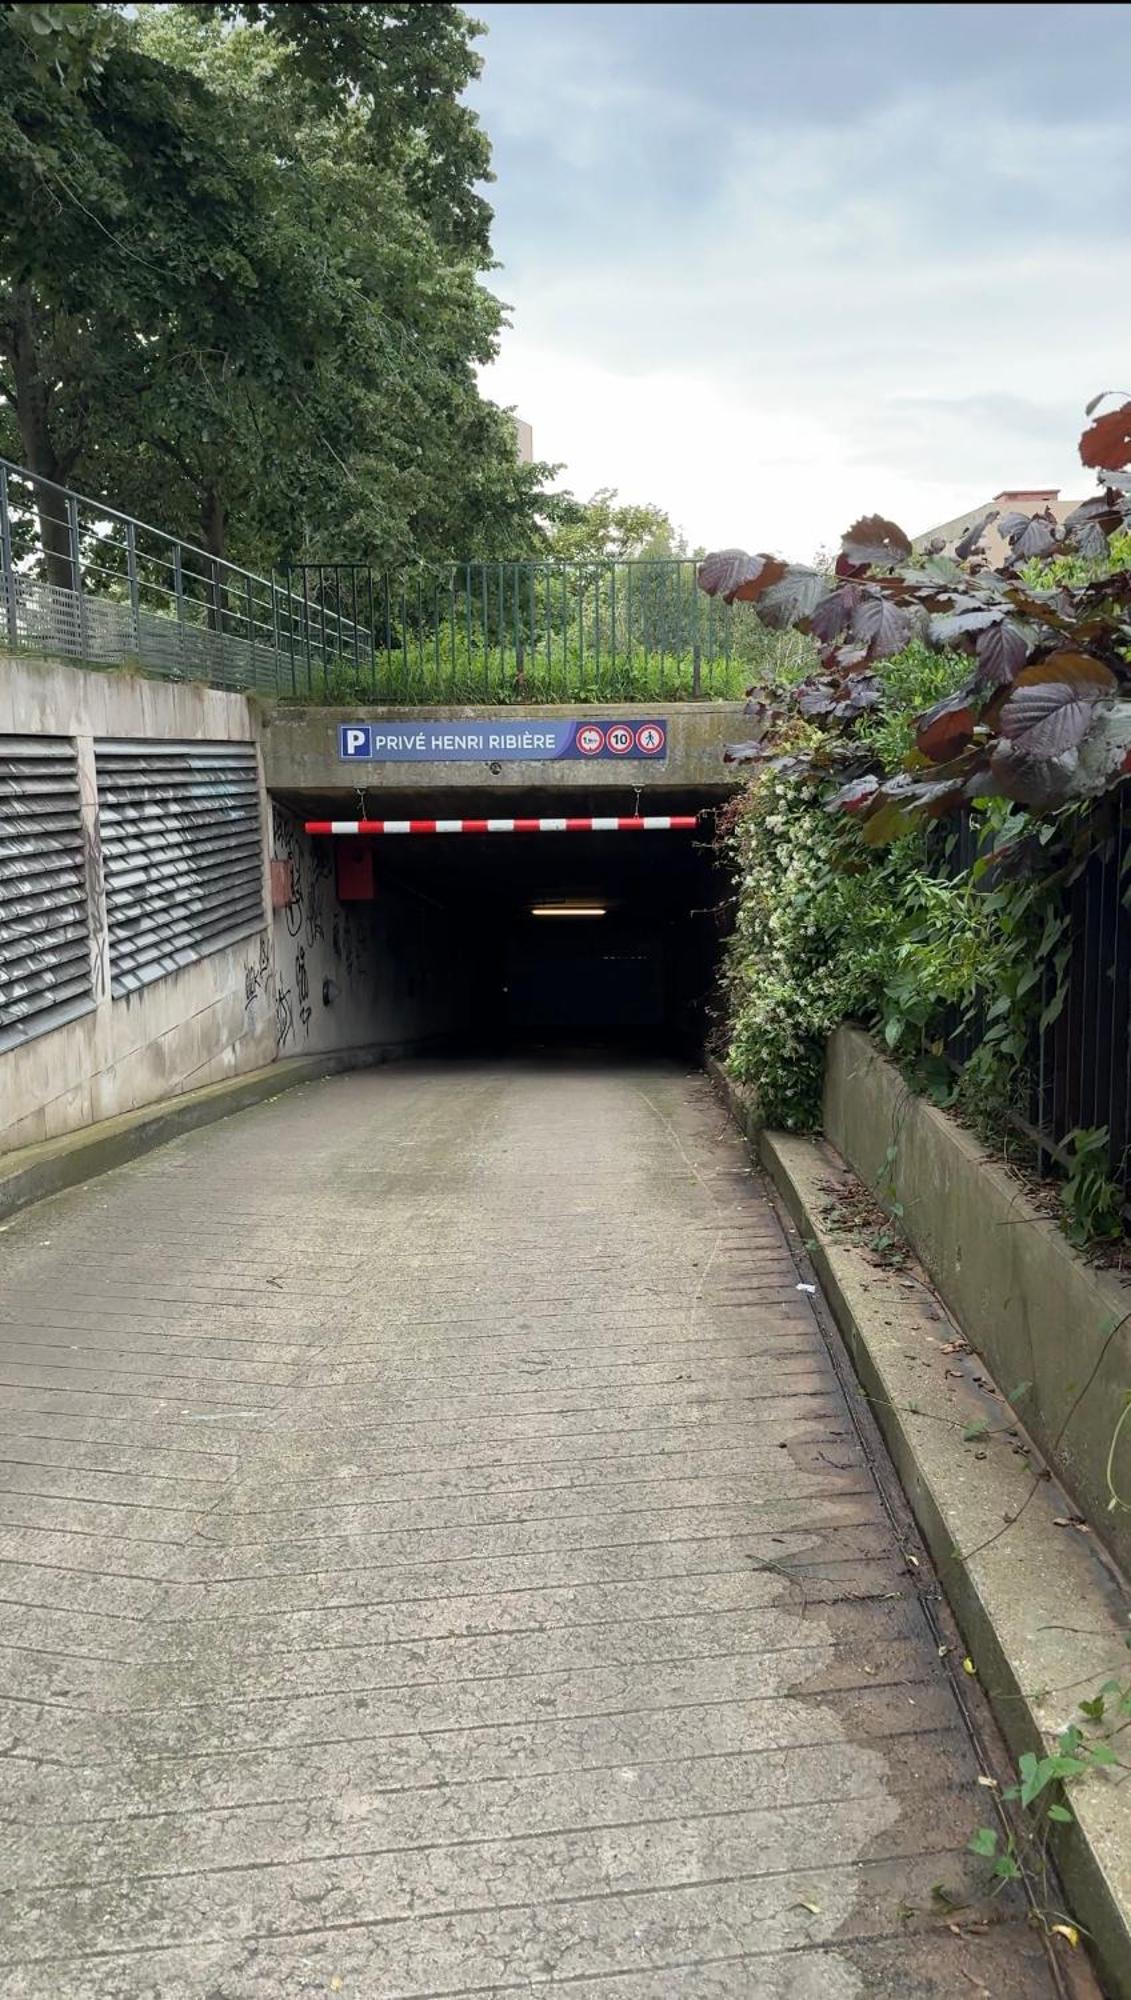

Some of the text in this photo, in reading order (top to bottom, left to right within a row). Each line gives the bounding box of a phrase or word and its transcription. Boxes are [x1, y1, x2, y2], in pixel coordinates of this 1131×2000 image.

[347, 730, 555, 754] P PRIVÉ HENRI RIBIÈRE
[612, 734, 628, 745] 10
